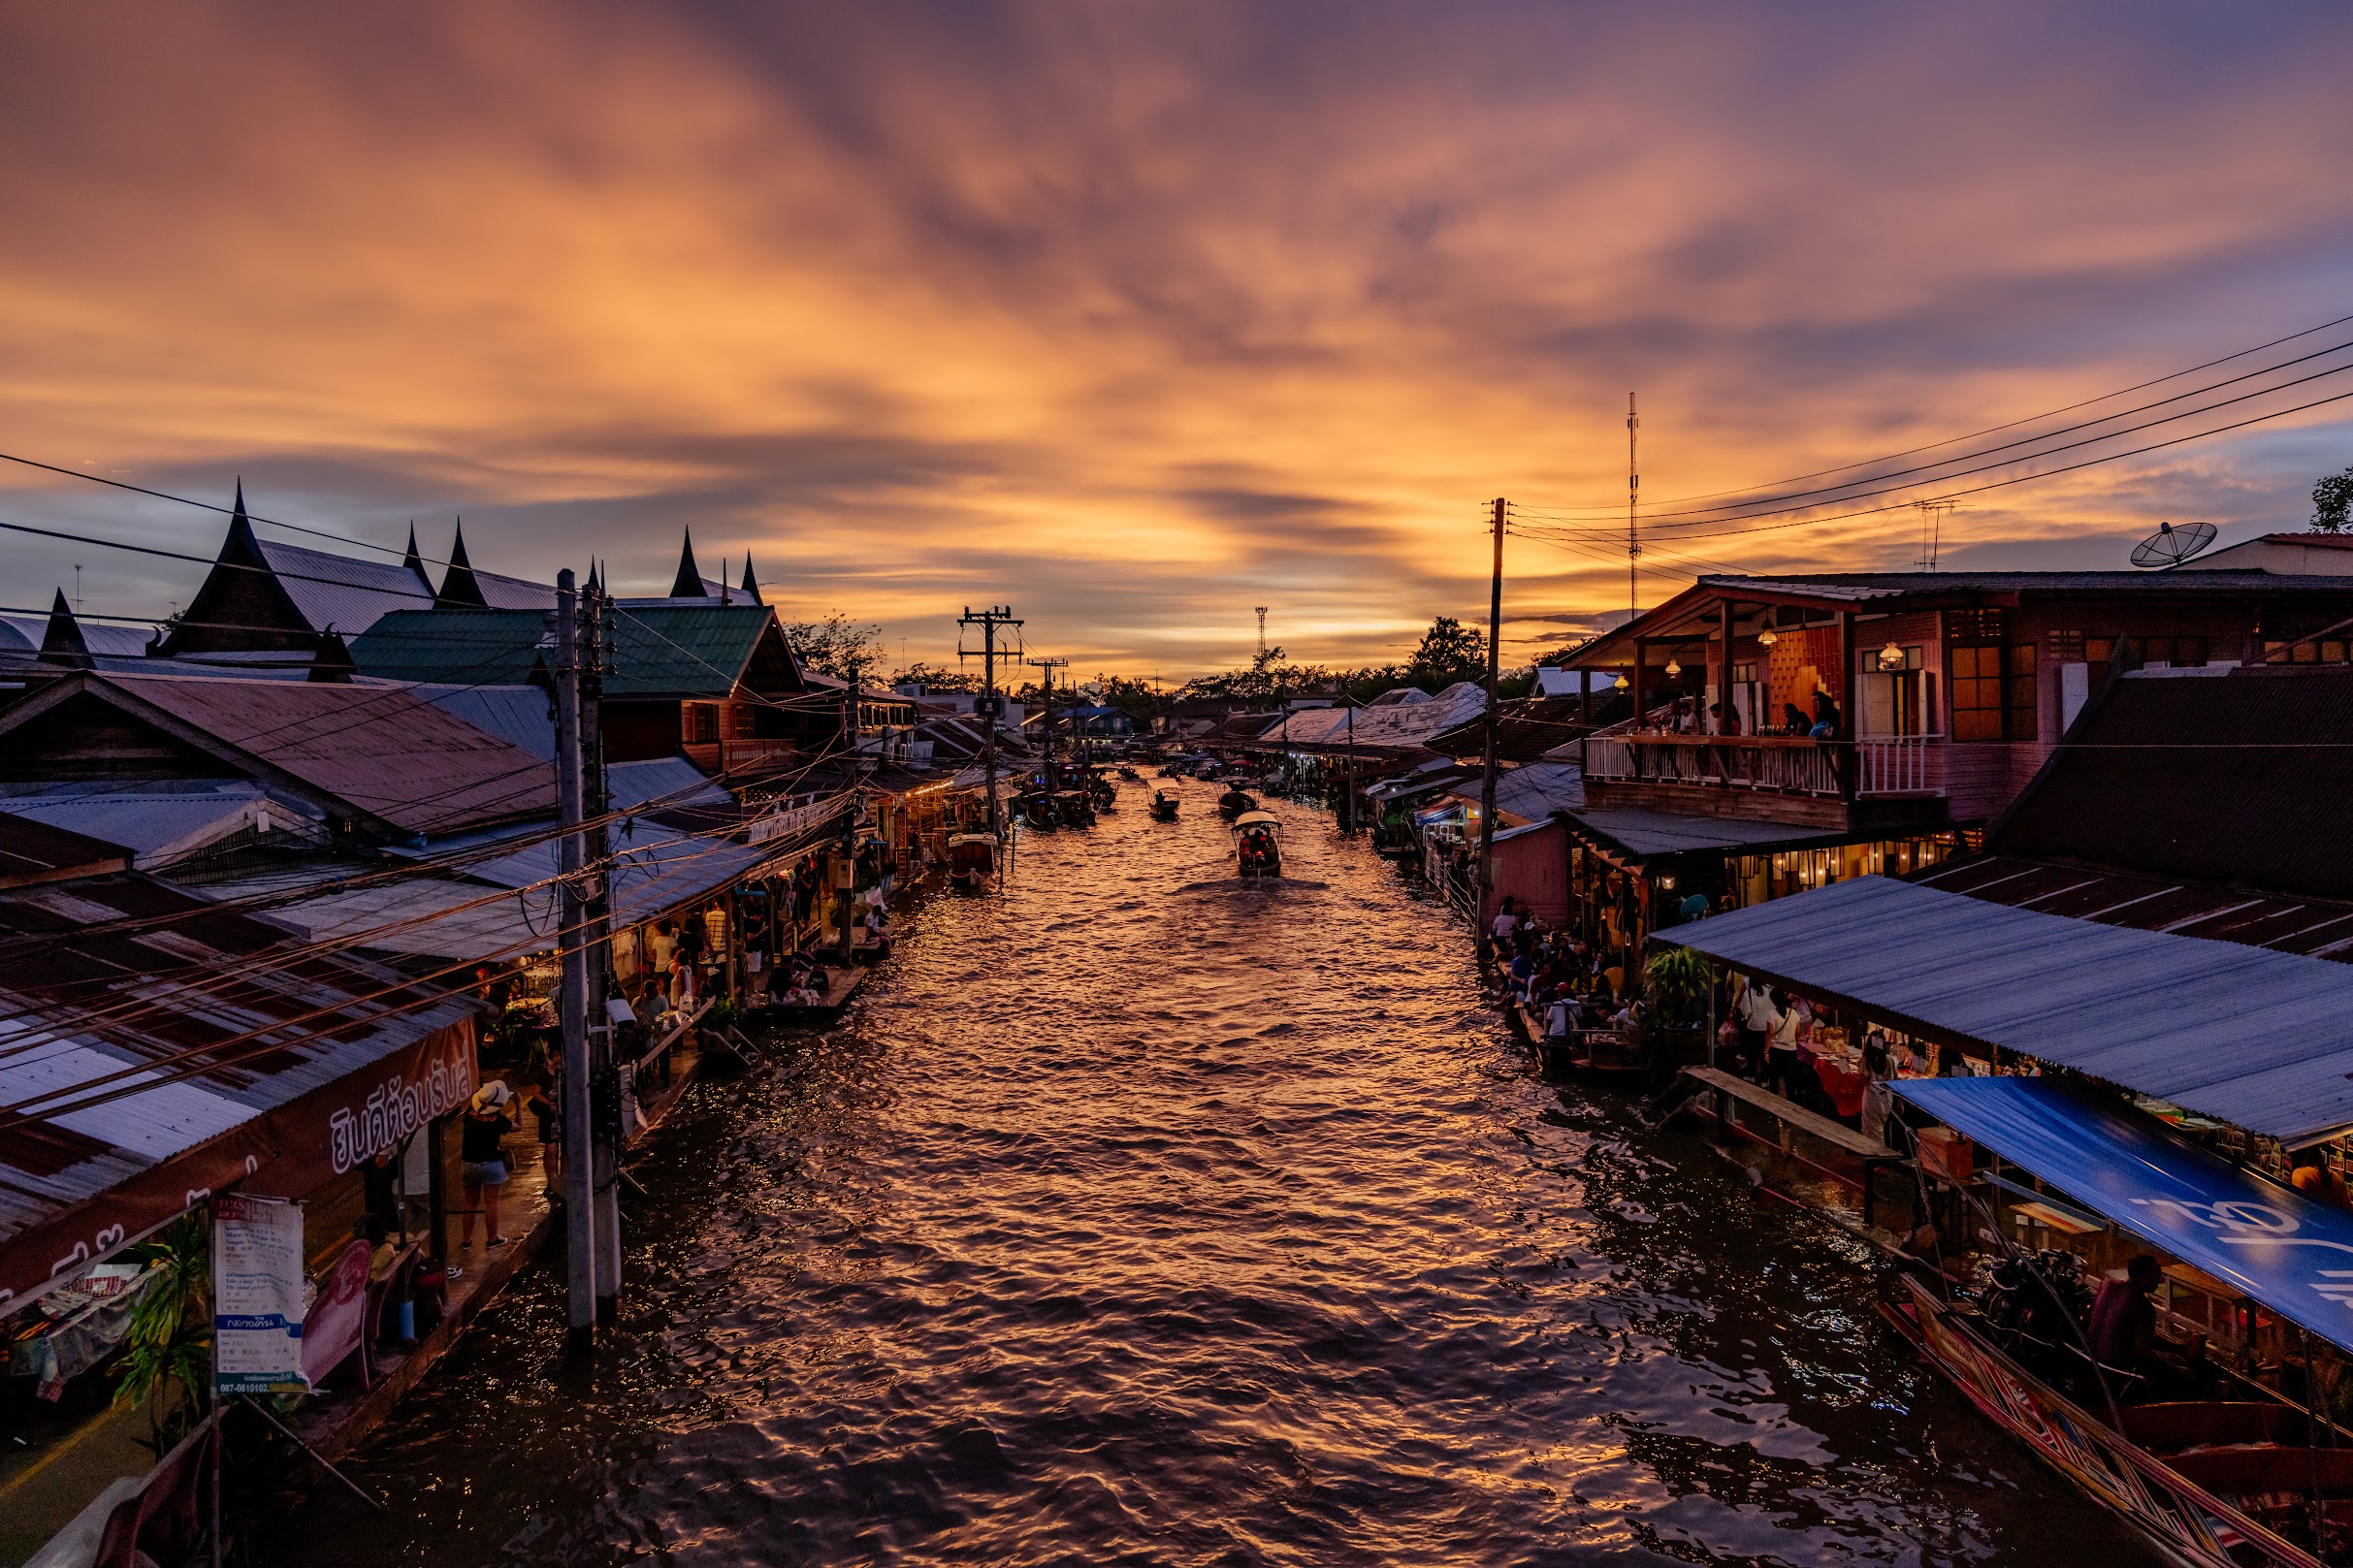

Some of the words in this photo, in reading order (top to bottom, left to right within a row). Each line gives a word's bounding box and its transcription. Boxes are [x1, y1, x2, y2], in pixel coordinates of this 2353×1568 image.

[331, 1039, 472, 1174] ยินดีต้อนรับส่
